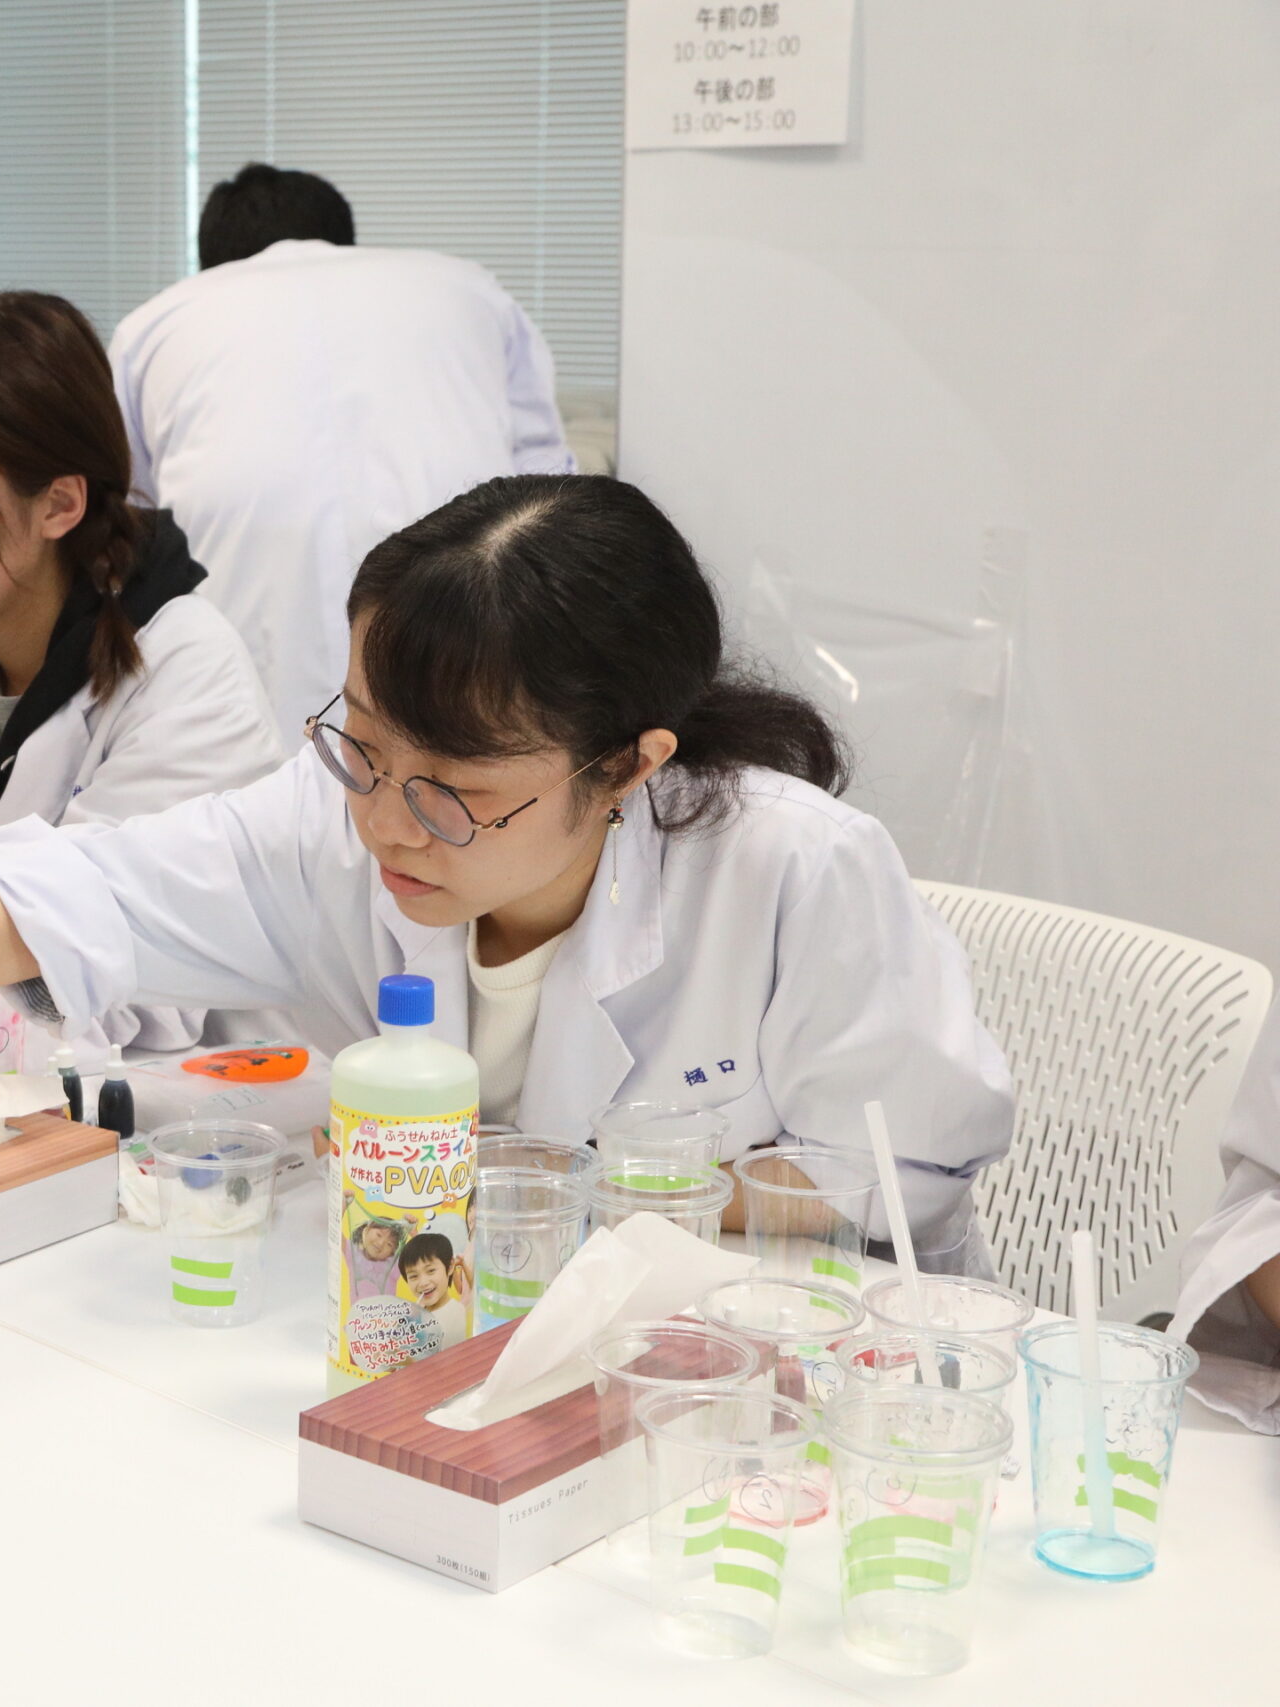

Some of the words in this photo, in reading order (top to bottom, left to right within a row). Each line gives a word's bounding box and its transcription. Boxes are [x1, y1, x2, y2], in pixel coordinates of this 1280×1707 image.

[696, 4, 780, 31] 午前の部
[694, 77, 776, 103] 午後の部
[384, 1128, 459, 1143] ふうせんねん土
[352, 1137, 473, 1163] バルーンスライム
[508, 1497, 552, 1525] Tissues
[558, 1479, 588, 1502] Paper
